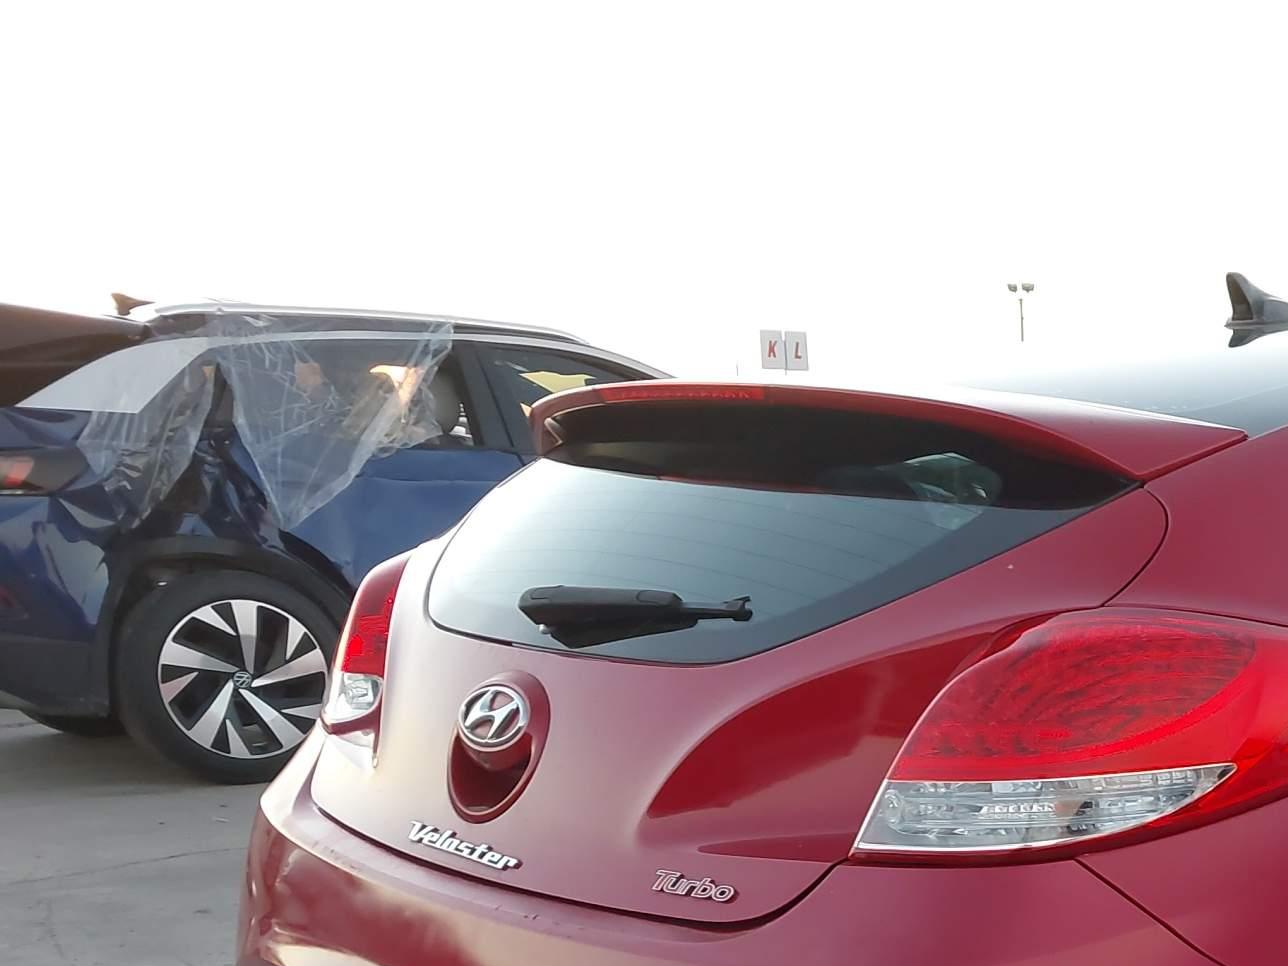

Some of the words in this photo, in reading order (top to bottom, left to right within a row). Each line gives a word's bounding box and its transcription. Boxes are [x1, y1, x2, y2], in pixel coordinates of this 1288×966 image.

[767, 340, 777, 358] K
[794, 341, 802, 359] L
[408, 820, 520, 870] Veloster
[652, 869, 736, 902] Turbo
